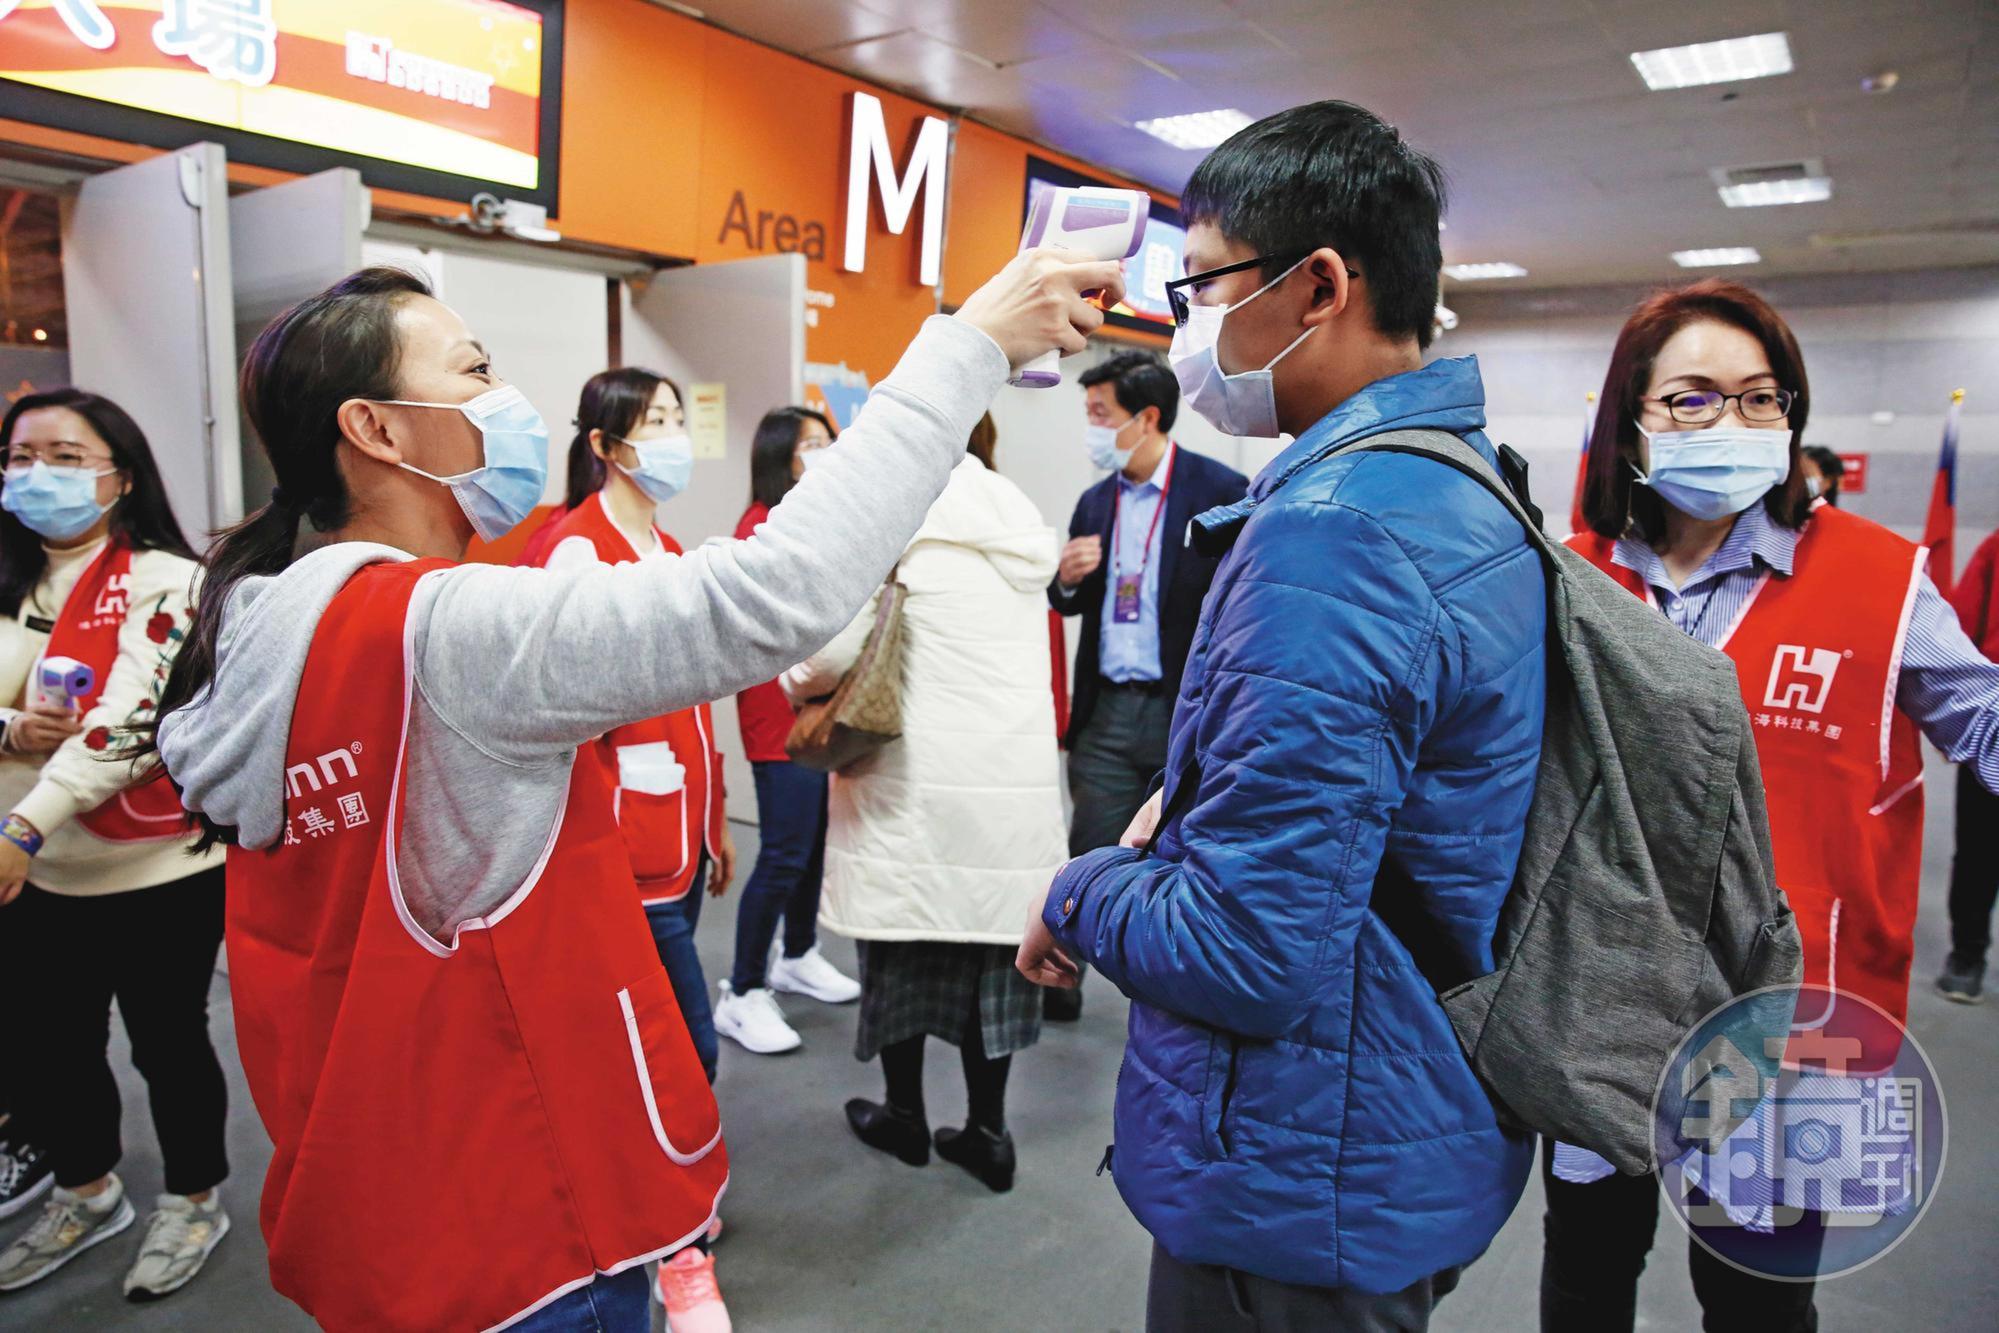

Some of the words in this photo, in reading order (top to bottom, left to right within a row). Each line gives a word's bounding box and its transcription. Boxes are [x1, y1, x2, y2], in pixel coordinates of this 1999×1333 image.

[718, 190, 827, 262] Area
[844, 91, 949, 287] M
[1748, 712, 1842, 740] 海科技集團
